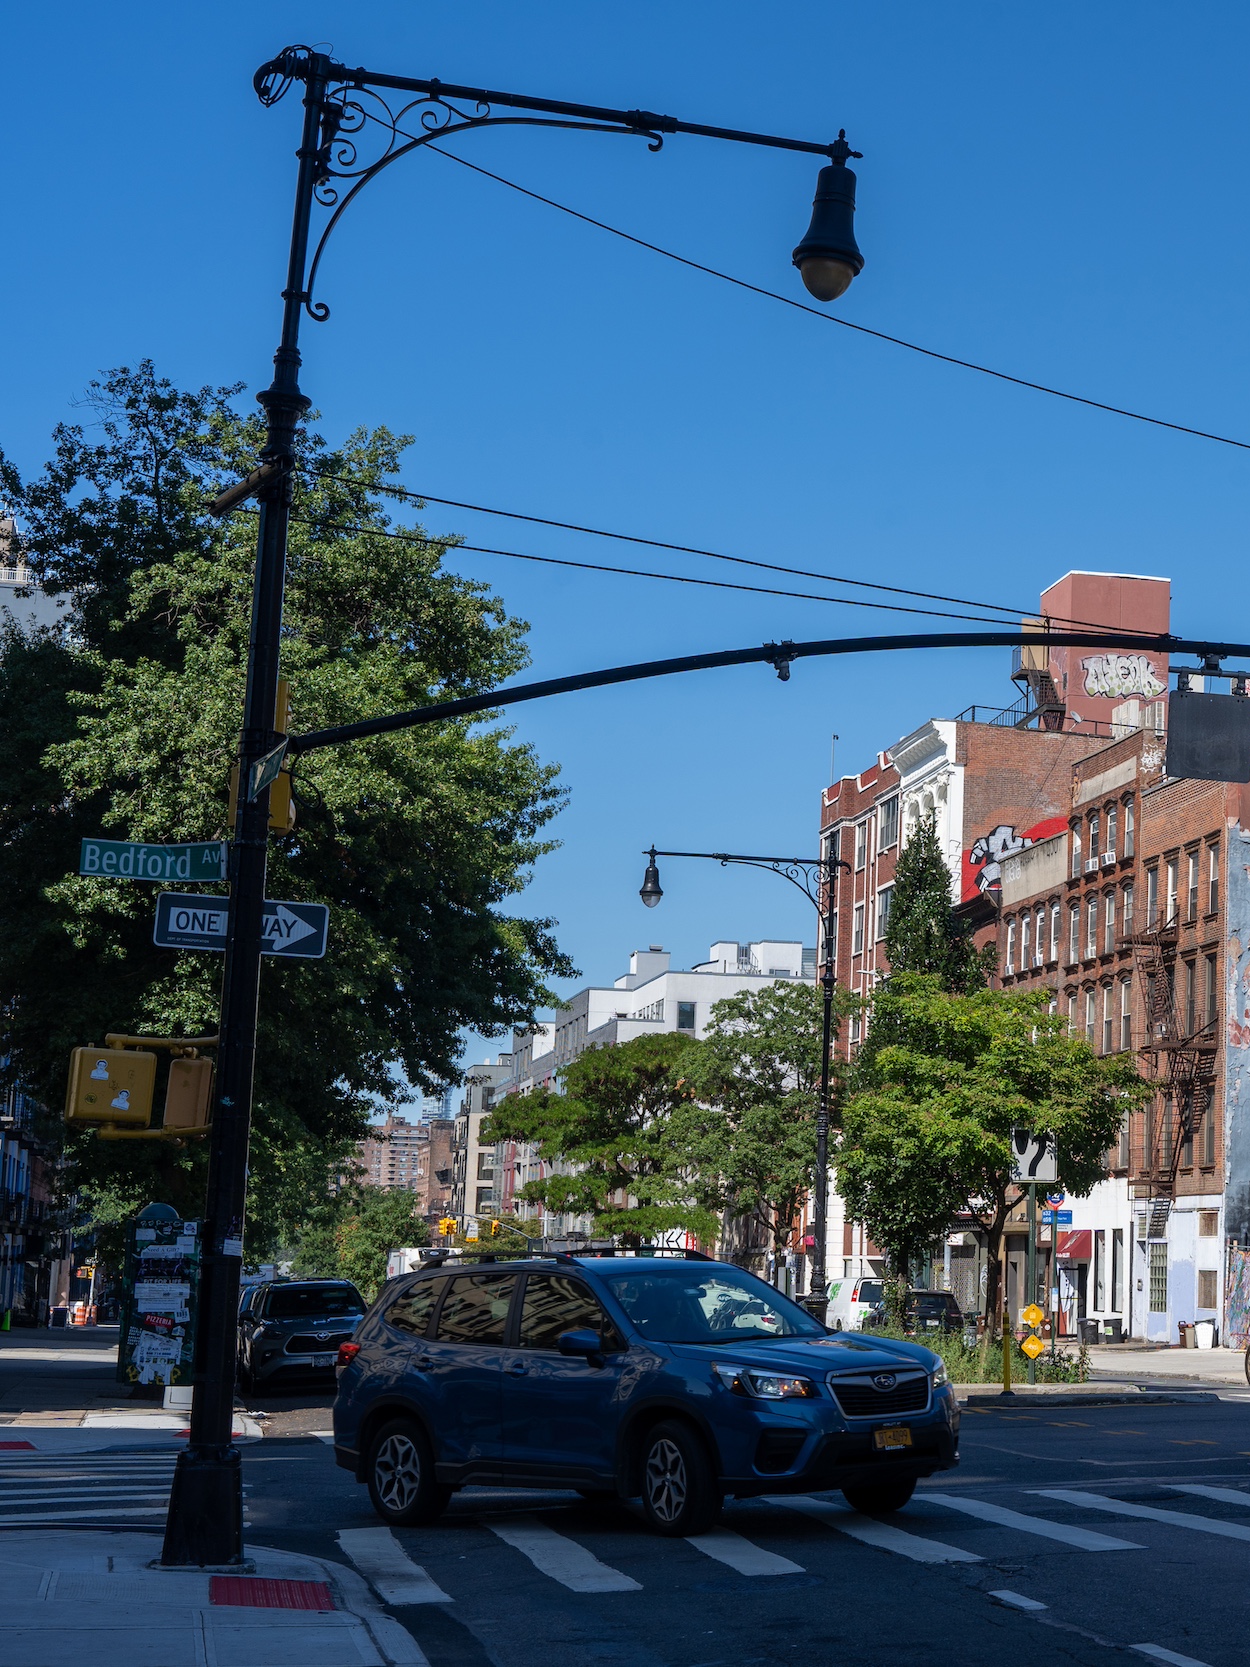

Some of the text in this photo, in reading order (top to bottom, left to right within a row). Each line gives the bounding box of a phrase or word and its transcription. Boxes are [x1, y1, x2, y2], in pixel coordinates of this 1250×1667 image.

[84, 845, 221, 878] Bedford Av
[175, 911, 221, 932] ONE
[146, 1314, 172, 1325] PIZZERIA
